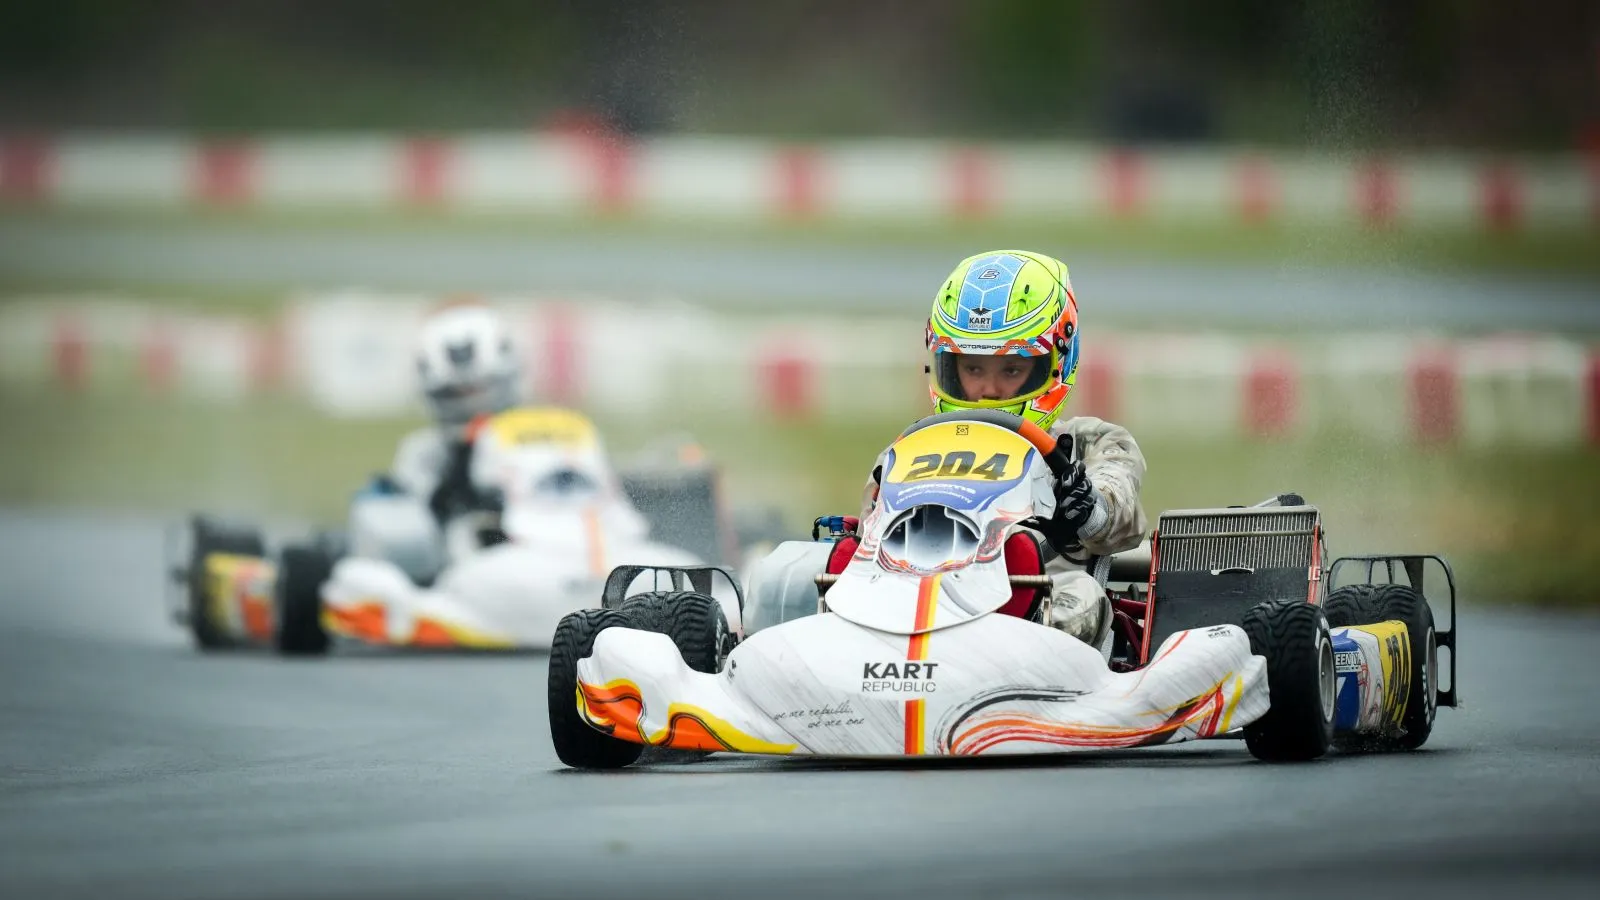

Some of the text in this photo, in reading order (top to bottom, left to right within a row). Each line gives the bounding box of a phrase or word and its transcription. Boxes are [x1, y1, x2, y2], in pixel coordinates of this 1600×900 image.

[969, 317, 991, 325] KART
[902, 450, 1010, 483] 204
[863, 662, 939, 680] KART
[862, 681, 937, 693] REPUBLIC
